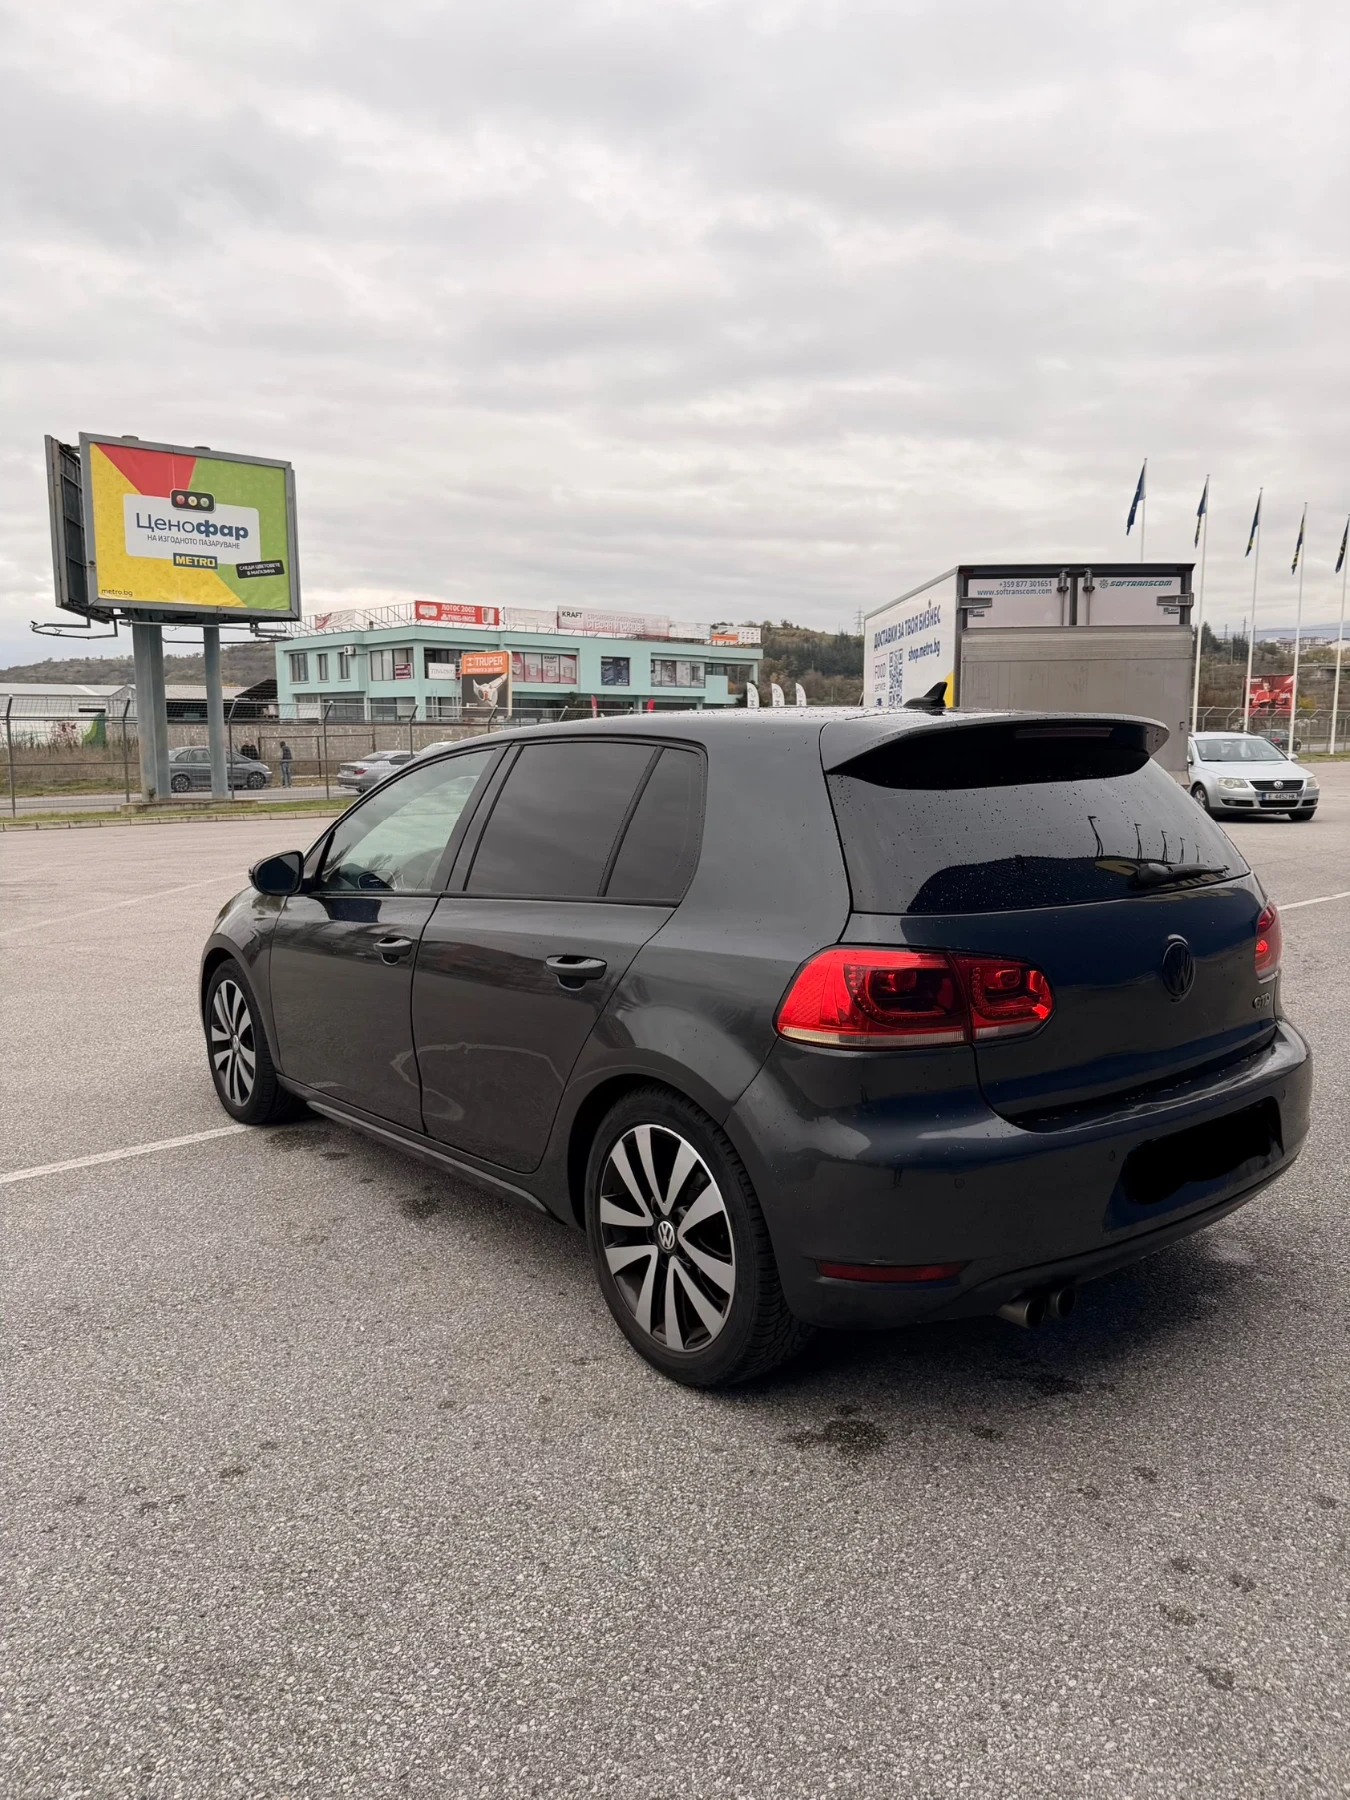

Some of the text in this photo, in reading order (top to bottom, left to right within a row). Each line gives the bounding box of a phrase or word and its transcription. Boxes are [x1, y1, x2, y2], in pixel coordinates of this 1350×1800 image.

[136, 512, 249, 541] Ценофар
[147, 534, 241, 549] НА ИЗГОДНОТО ПАЗАРУВАНЕ
[175, 555, 216, 567] METRO
[1016, 580, 1028, 588] 877
[101, 588, 133, 597] metro.bg
[977, 587, 1053, 596] www.softranscom.com
[562, 611, 583, 619] KRAFT
[874, 604, 941, 652] ДОСТАВКИ ЗА ТВОЯ БИЗНЕС
[908, 638, 941, 663] shop.metro.bg
[475, 655, 504, 667] TRUPER
